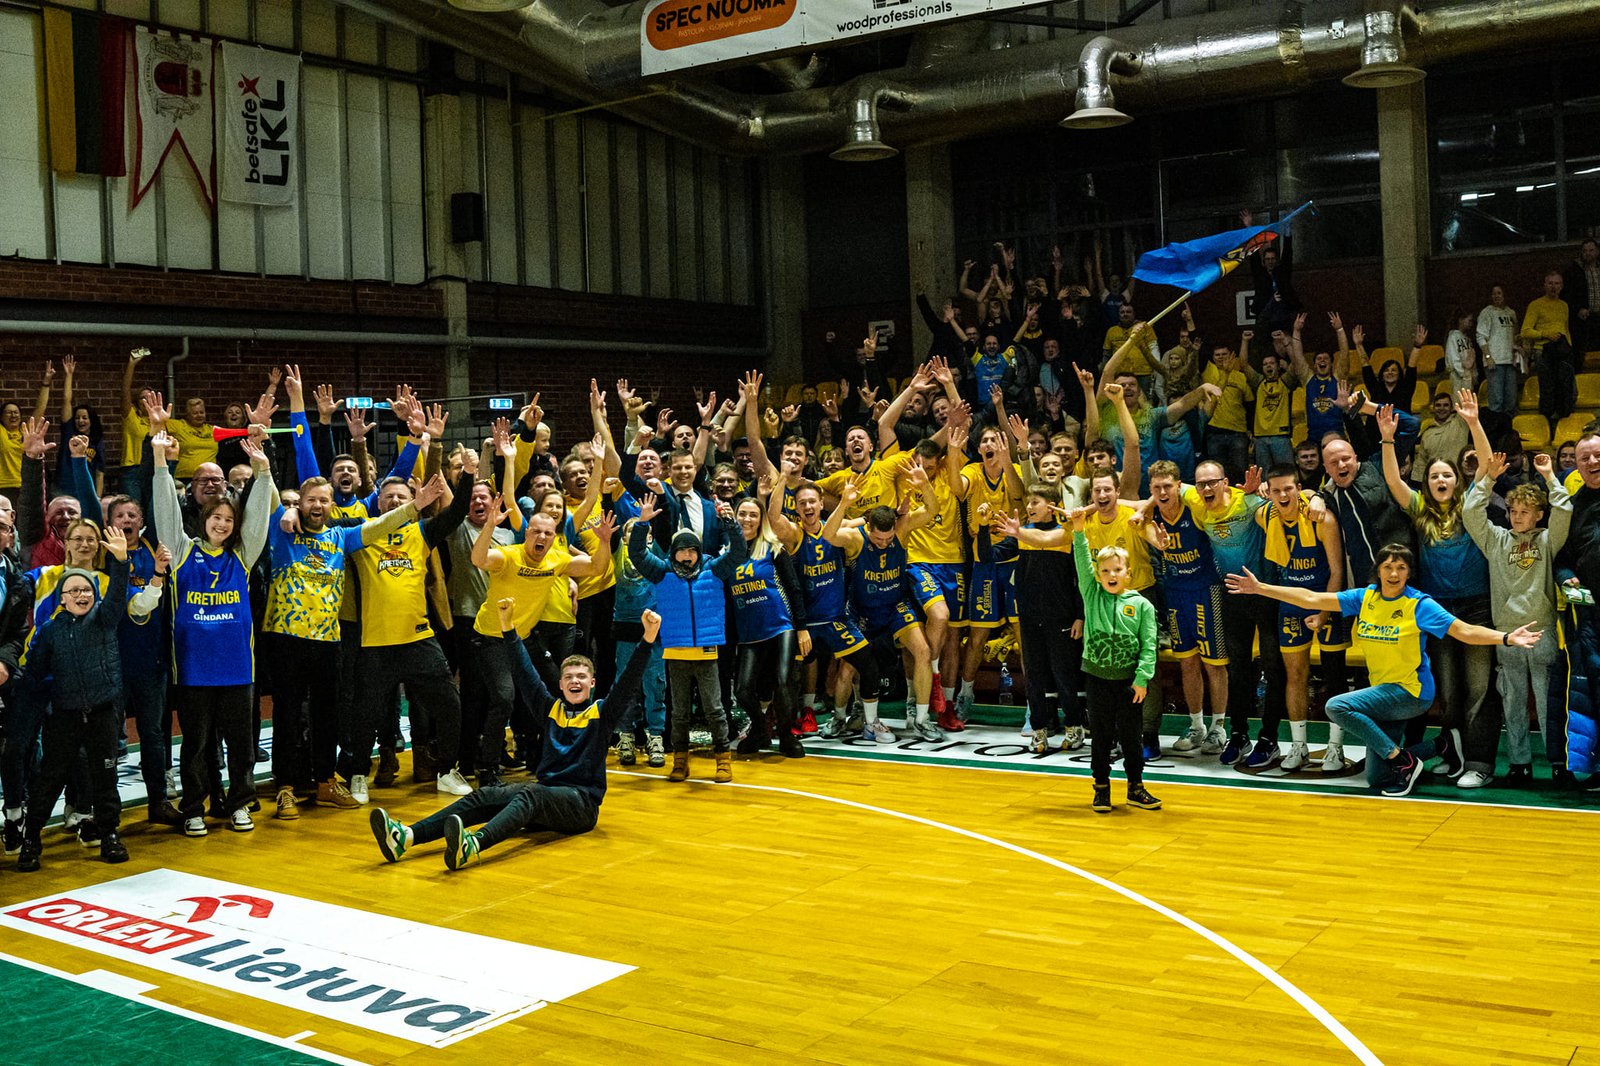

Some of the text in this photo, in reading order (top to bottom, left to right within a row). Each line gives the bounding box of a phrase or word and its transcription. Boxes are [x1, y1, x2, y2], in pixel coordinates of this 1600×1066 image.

[655, 6, 702, 32] SPEC
[836, 1, 953, 33] woodprofessionals
[241, 98, 261, 184] betsafe
[259, 79, 290, 187] LKL
[387, 533, 403, 545] 13
[1286, 535, 1297, 552] 7
[814, 544, 824, 561] 5
[209, 570, 220, 589] 7
[735, 562, 754, 580] 24
[731, 579, 767, 596] KRETINGA
[186, 590, 240, 606] KRETINGA
[840, 630, 856, 645] 5
[1321, 624, 1332, 642] 7
[27, 903, 492, 1033] ORLEN Lietuva
